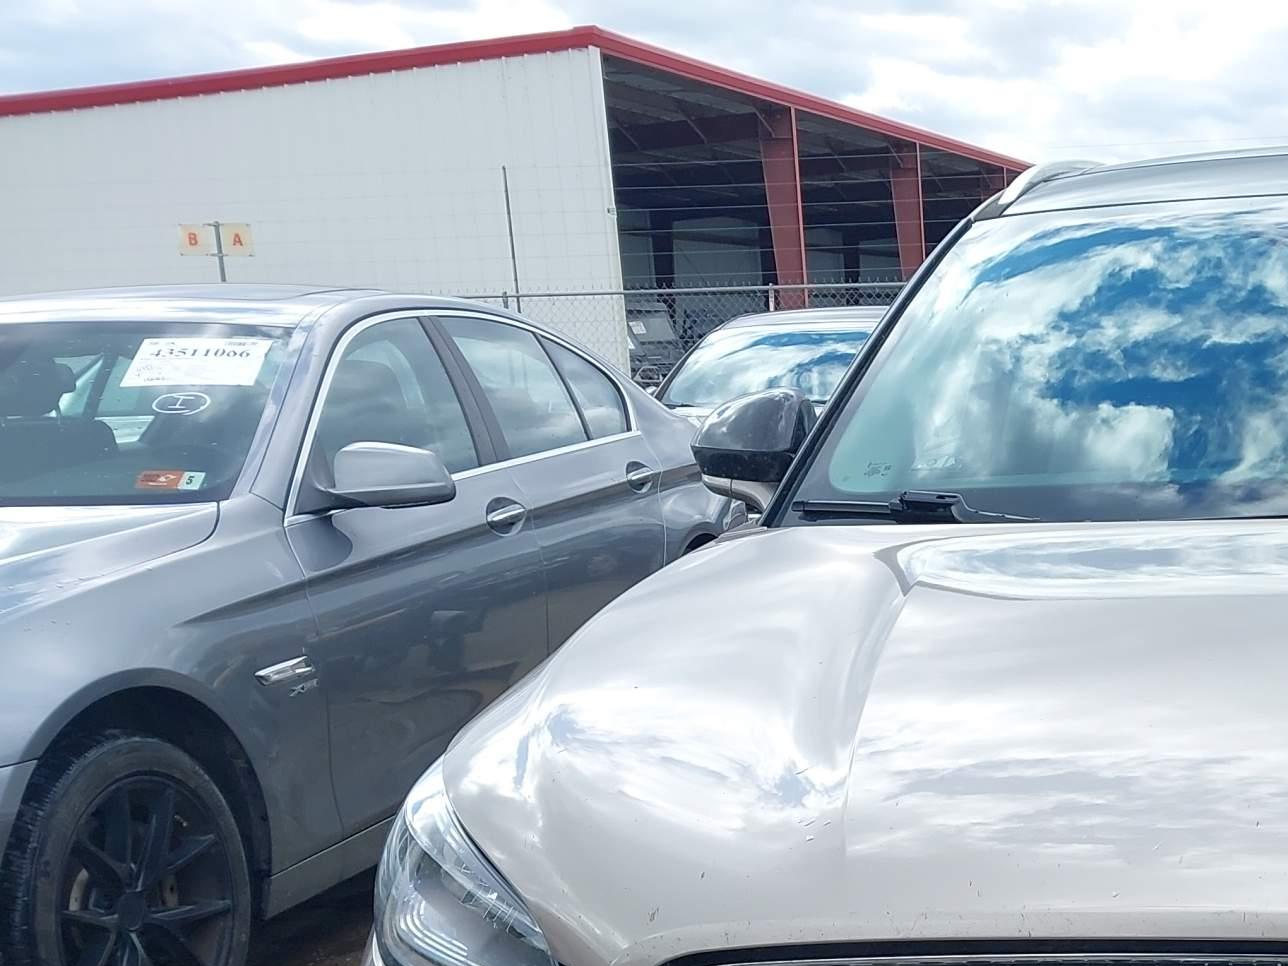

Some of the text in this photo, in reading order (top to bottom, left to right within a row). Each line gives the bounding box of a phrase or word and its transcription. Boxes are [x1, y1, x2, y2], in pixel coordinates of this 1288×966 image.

[187, 231, 199, 247] B
[232, 232, 244, 247] A
[185, 475, 195, 485] 5
